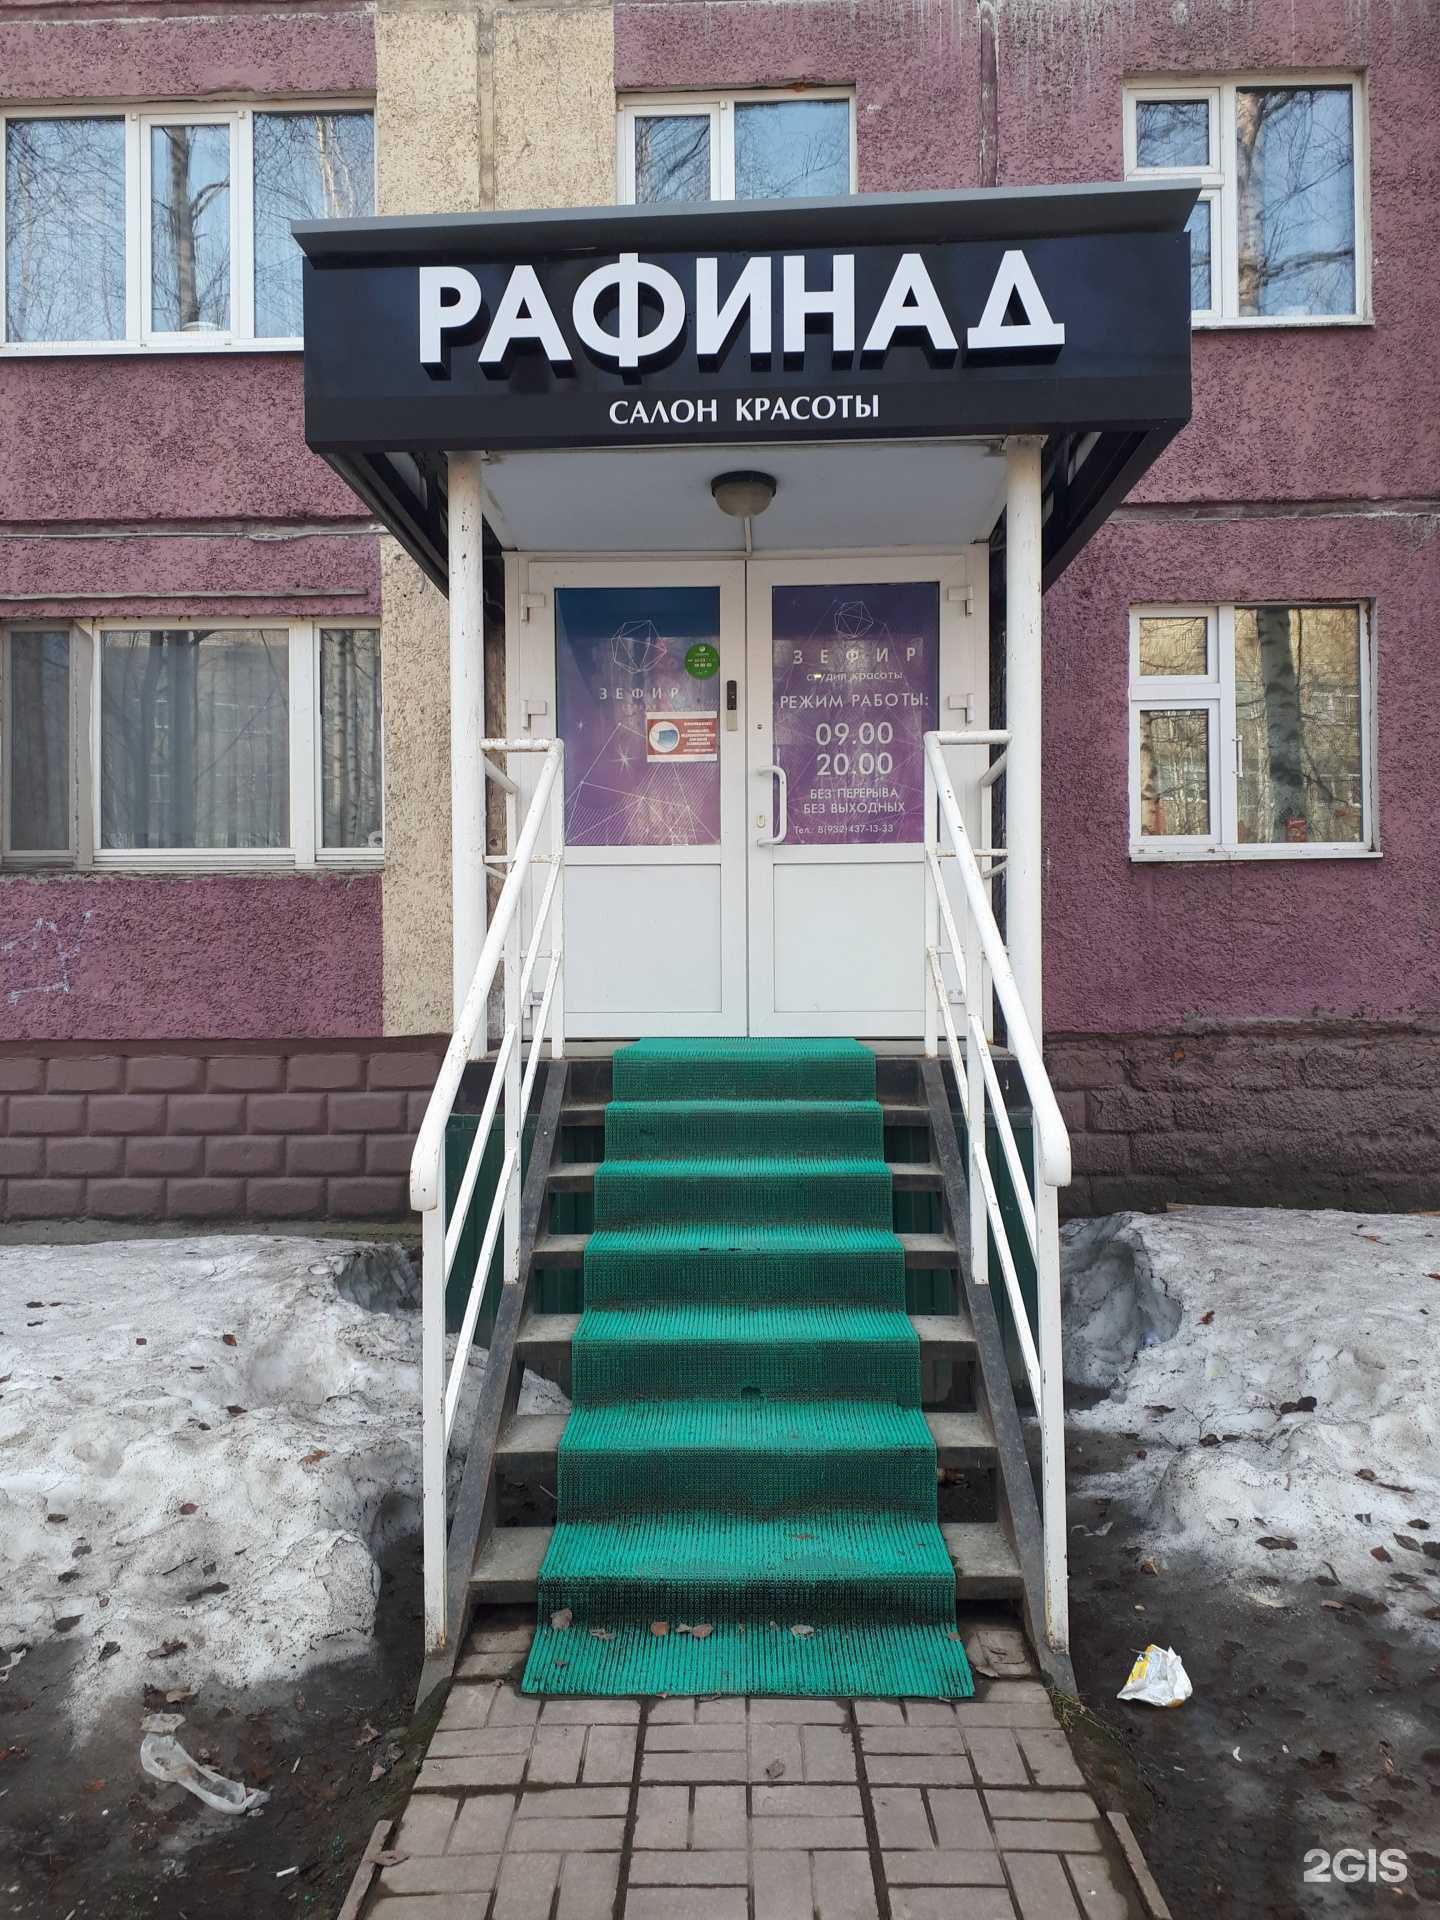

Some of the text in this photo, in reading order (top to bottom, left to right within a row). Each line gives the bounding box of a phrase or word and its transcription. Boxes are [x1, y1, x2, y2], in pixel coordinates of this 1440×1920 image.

[419, 250, 1066, 367] РАФИНАД
[609, 394, 880, 425] САЛОН КРАСОТЫ
[851, 671, 904, 683] красоты
[780, 692, 929, 709] РЕЖИМ РАБОТЫ:
[815, 721, 894, 746] 09.00
[816, 752, 893, 776] 20.00
[810, 786, 899, 800] БЕЗ ПЕРЕРЫВА
[803, 802, 906, 815] БЕЗ ВЫХОДНЫХ
